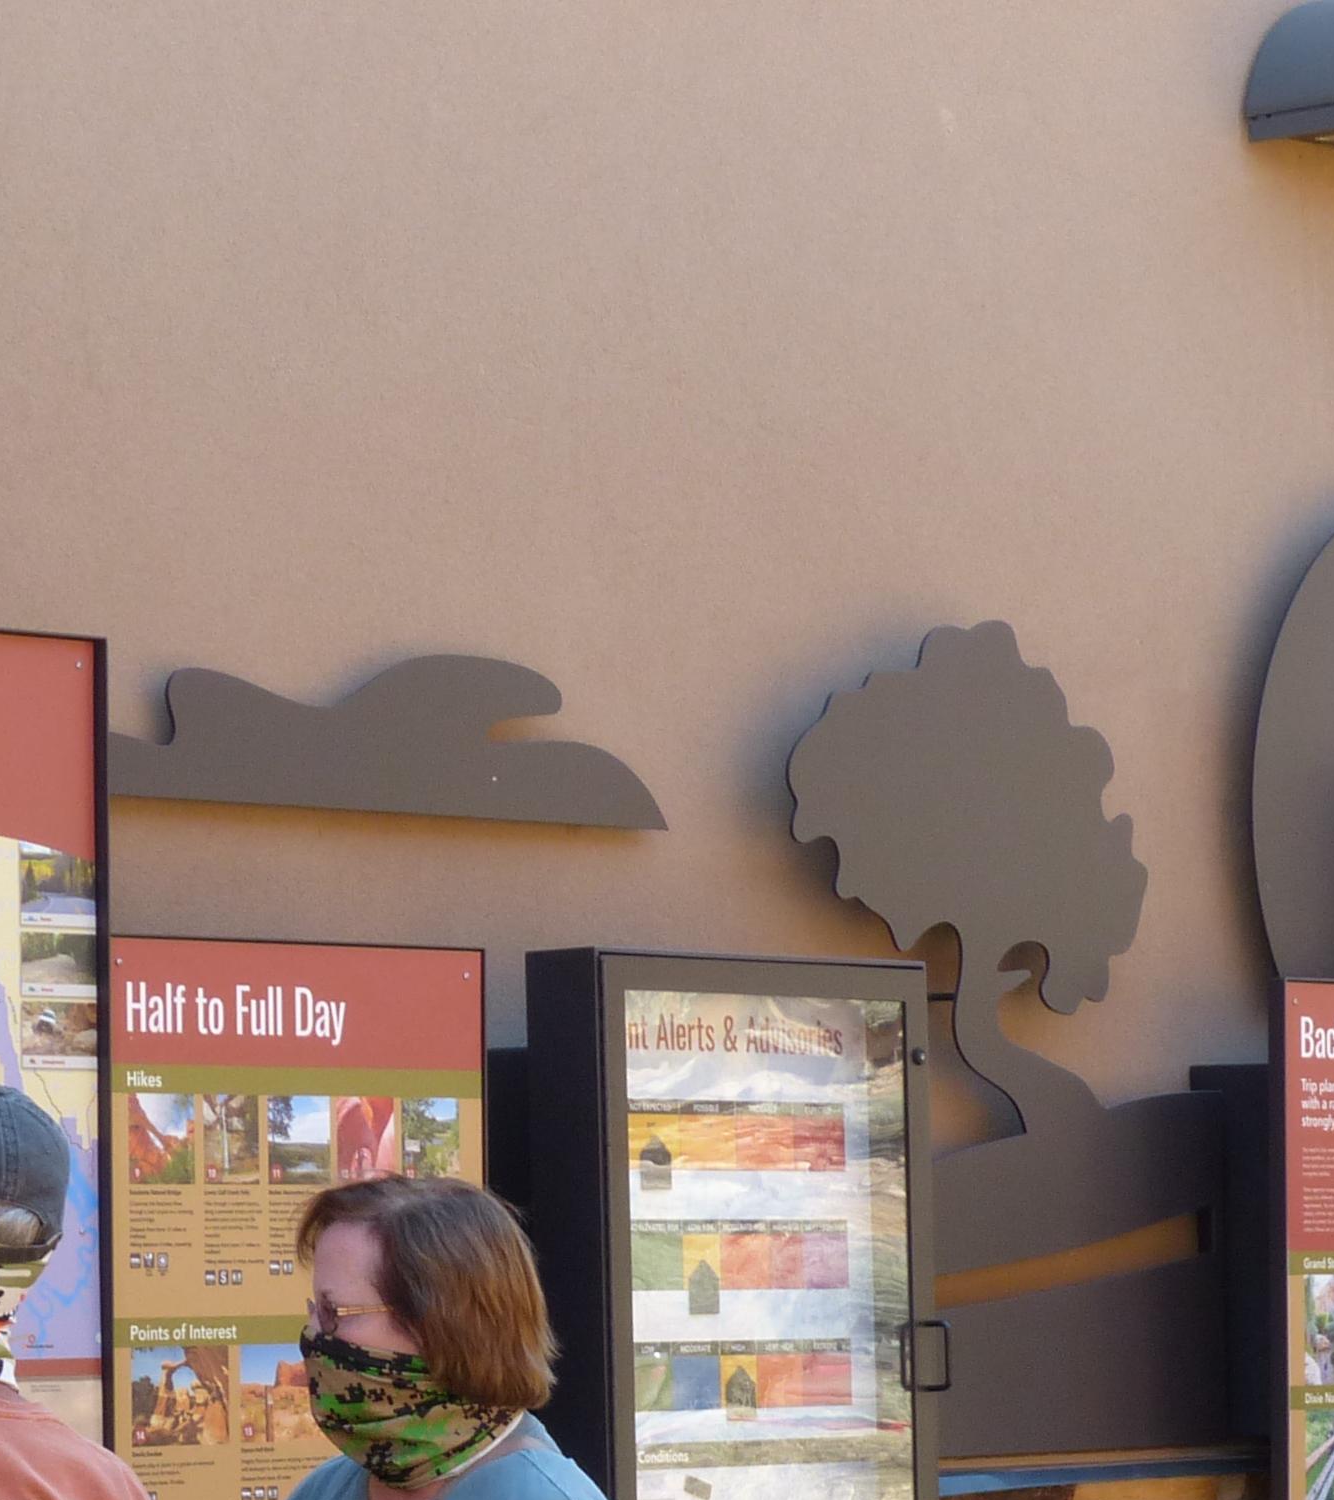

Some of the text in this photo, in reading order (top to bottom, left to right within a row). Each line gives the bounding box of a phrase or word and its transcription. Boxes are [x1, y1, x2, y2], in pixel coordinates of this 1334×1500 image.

[125, 980, 346, 1046] Half to Full Day
[657, 1013, 715, 1051] Alerts
[723, 1015, 737, 1052] &
[746, 1015, 843, 1055] Advisories
[126, 1070, 162, 1087] Hikes
[1301, 1078, 1317, 1094] Trip
[1301, 1097, 1320, 1110] with
[1322, 1101, 1327, 1110] a
[1301, 1115, 1334, 1131] strongly
[1303, 1257, 1326, 1270] Grand
[130, 1323, 237, 1341] Points of Interest
[1305, 1392, 1324, 1404] Dixie
[136, 1430, 145, 1441] 14
[637, 1450, 689, 1464] Conditions
